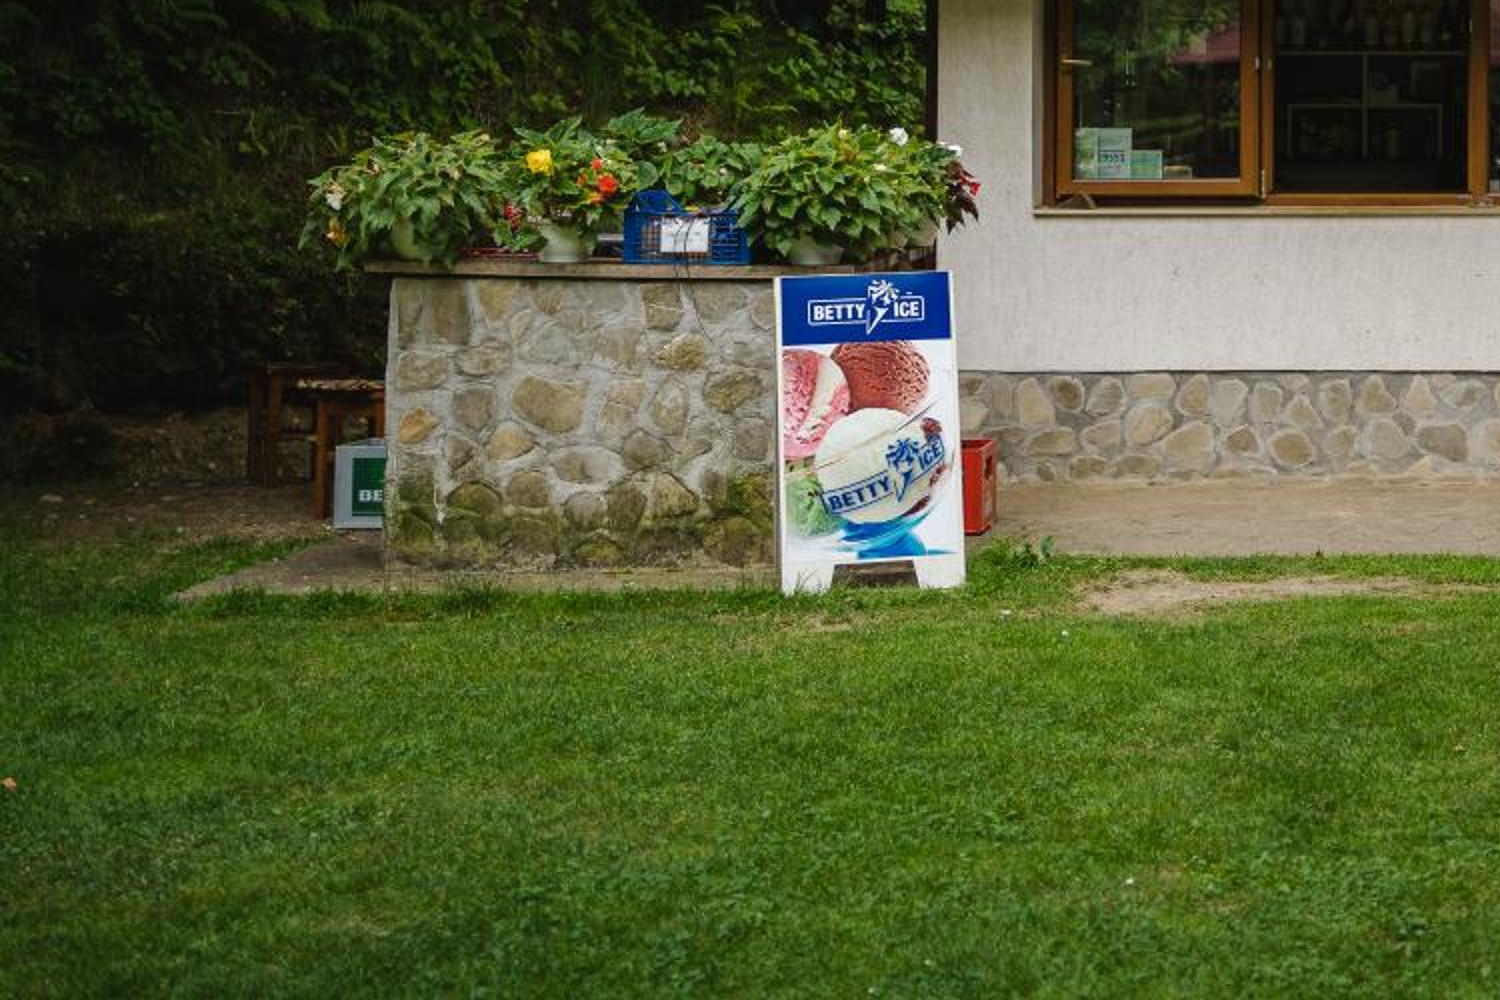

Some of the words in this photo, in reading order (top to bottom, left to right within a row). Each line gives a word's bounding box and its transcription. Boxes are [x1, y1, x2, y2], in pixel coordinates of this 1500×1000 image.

[813, 303, 866, 321] BETTY
[894, 301, 920, 317] ICE
[827, 475, 890, 511] BETTY
[918, 440, 942, 470] ICE
